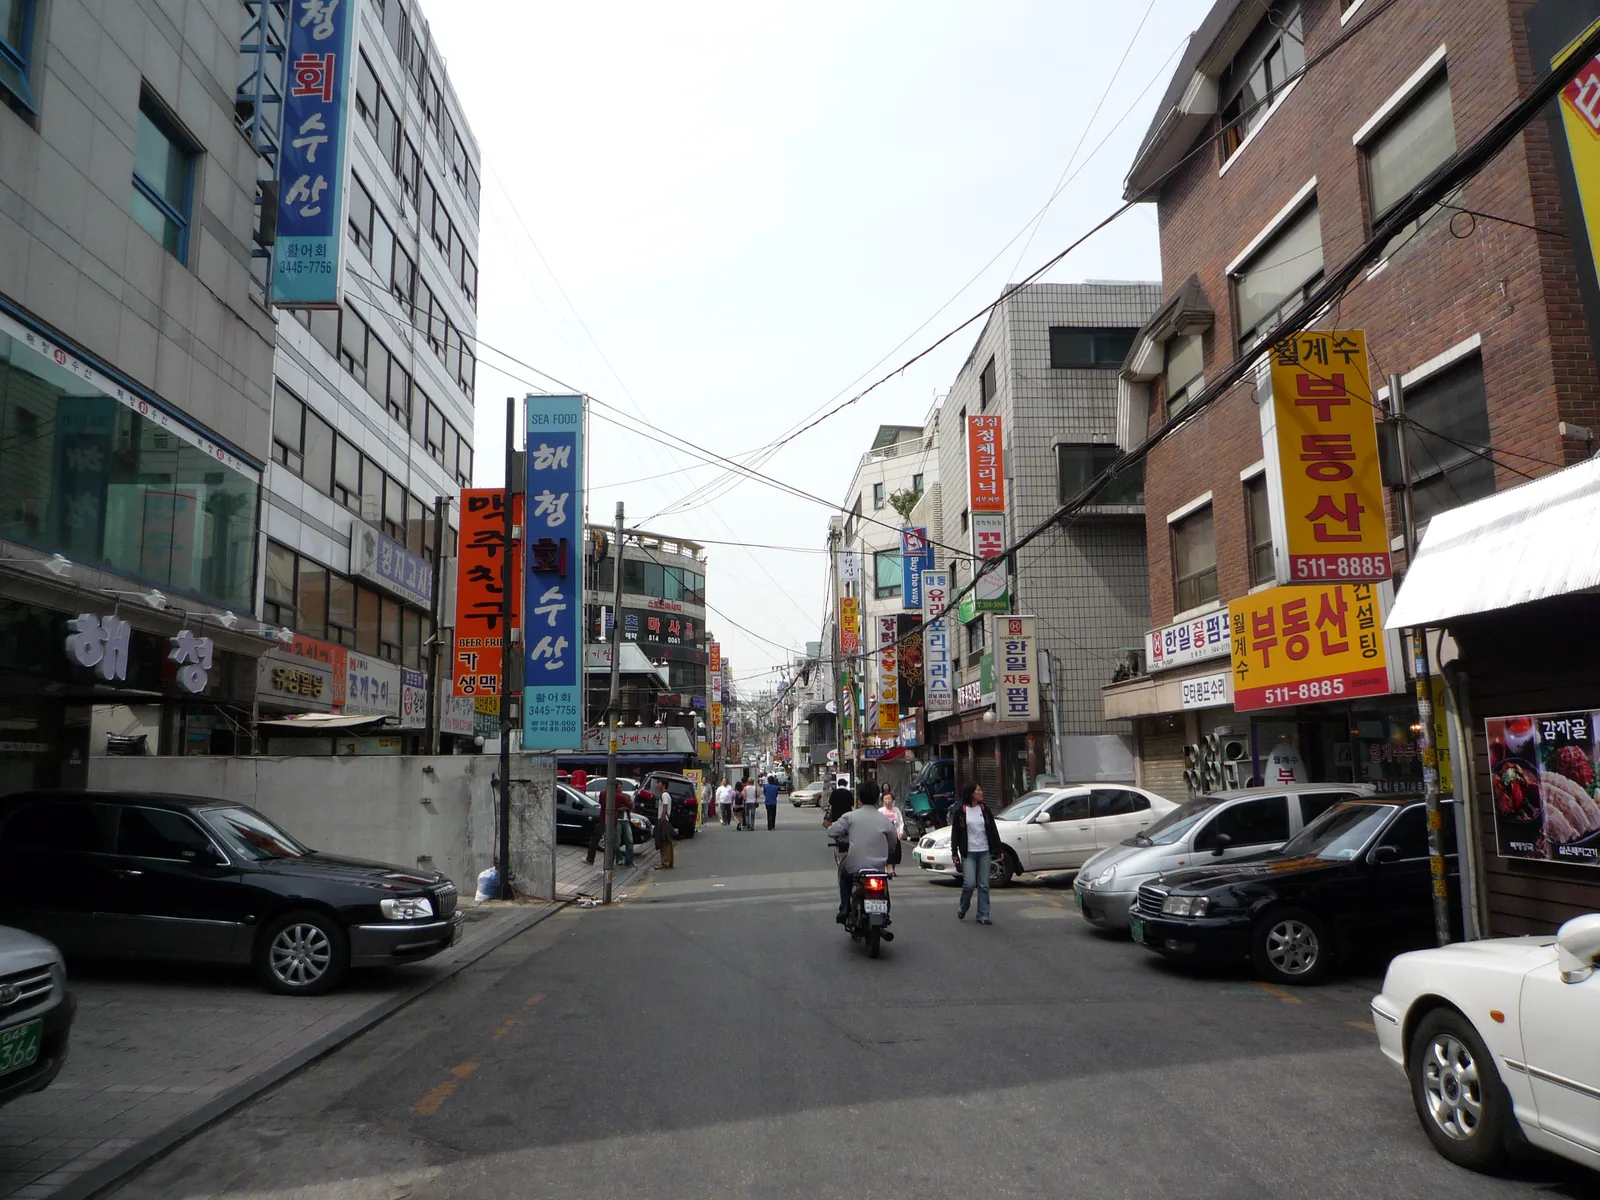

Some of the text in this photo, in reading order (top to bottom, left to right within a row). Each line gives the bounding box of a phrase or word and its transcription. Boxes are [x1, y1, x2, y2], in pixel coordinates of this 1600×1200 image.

[287, 244, 327, 258] 활어회
[280, 260, 331, 274] 3445-7756
[531, 413, 577, 425] SEA FOOD
[1295, 373, 1365, 542] 부동산
[1297, 556, 1385, 578] 511-8885
[1252, 585, 1350, 669] 부동산
[459, 638, 482, 647] BEER
[1233, 613, 1249, 681] 월계수
[1005, 641, 1028, 671] 한일
[1003, 674, 1031, 684] 자동
[536, 693, 571, 703] 활어회
[1265, 678, 1345, 704] 511-8885
[529, 705, 577, 716] 3445-7756
[1007, 688, 1030, 717] 펌프
[1542, 718, 1588, 741] 감자골
[1273, 755, 1299, 765] 월계수
